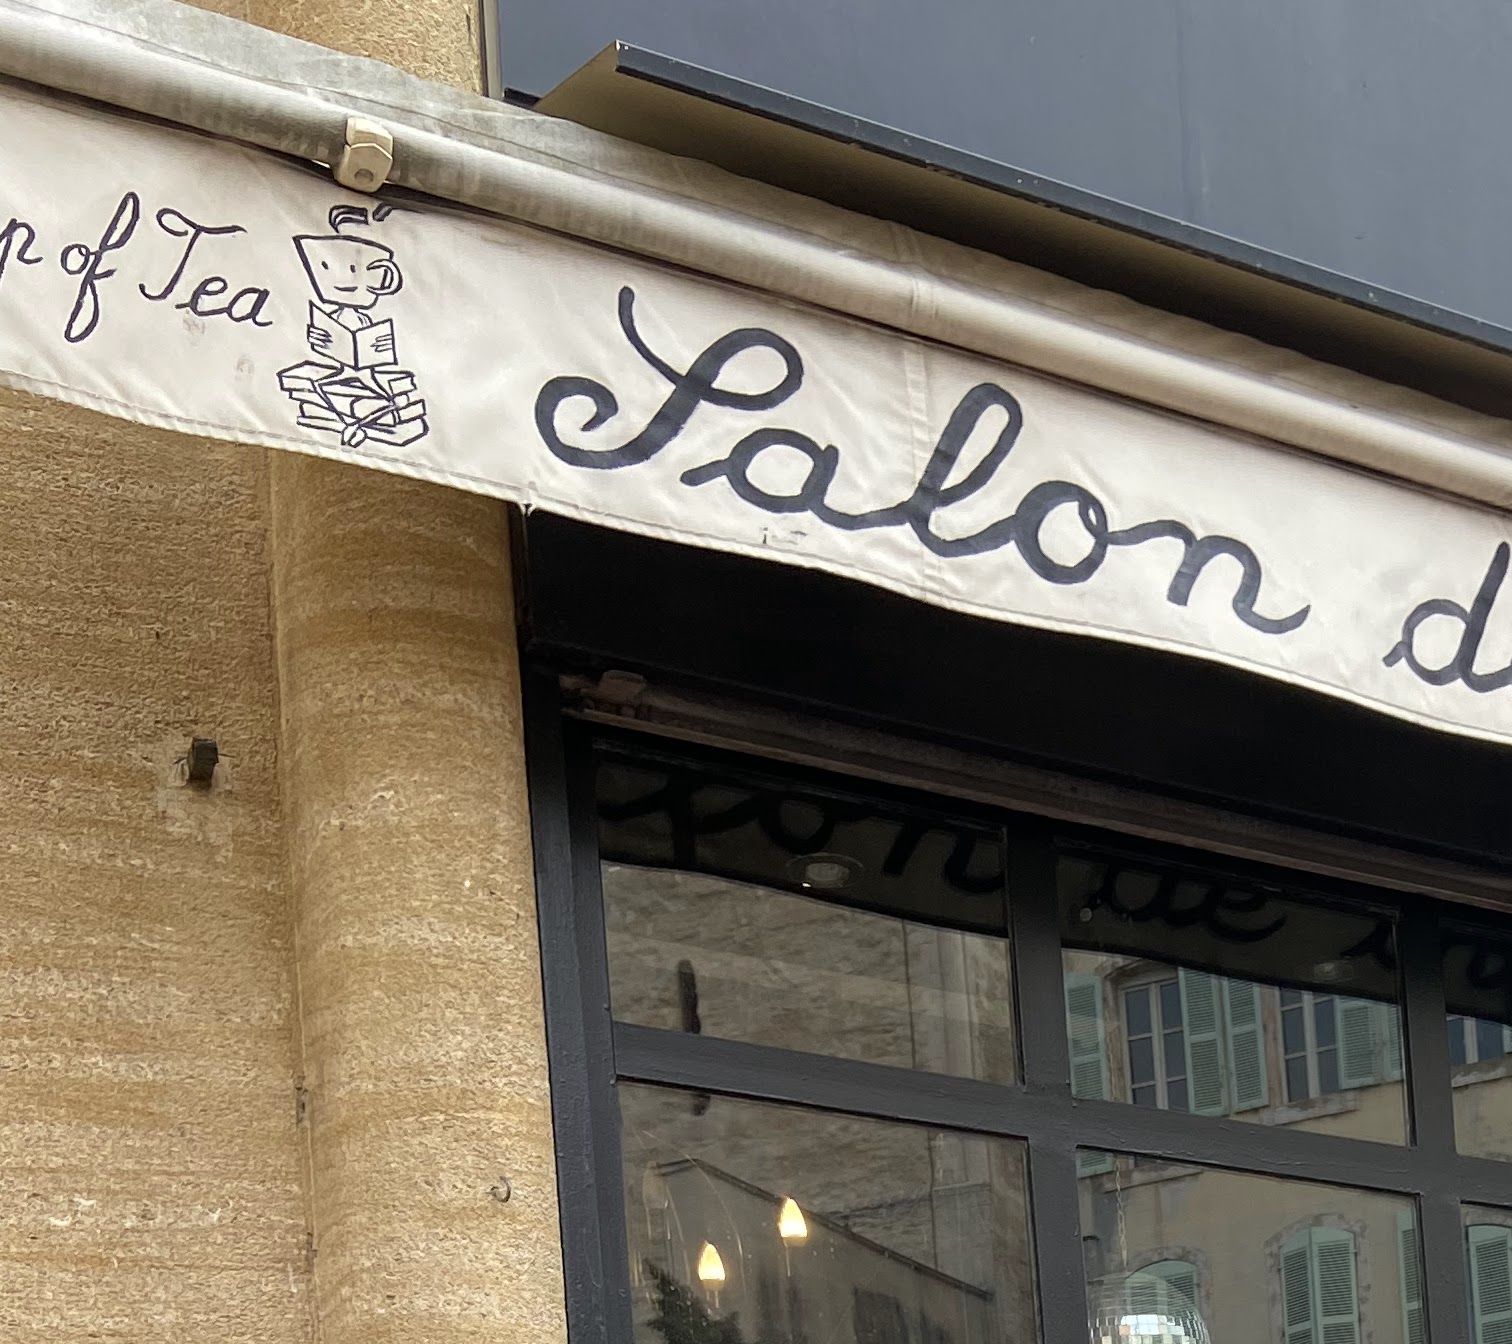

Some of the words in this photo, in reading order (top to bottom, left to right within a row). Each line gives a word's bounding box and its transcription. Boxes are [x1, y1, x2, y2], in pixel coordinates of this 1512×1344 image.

[60, 192, 141, 342] of
[139, 207, 273, 329] Tea
[535, 286, 1312, 635] Salon
